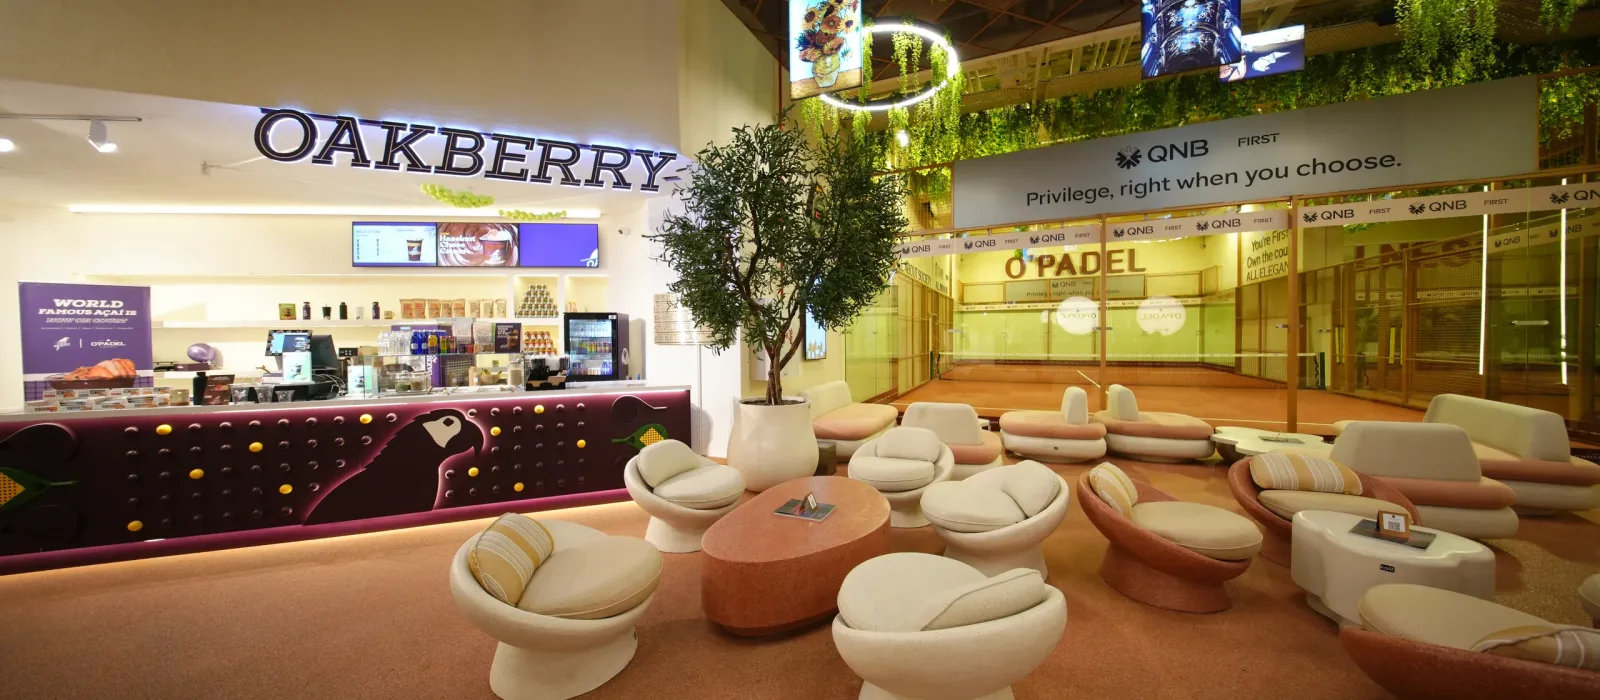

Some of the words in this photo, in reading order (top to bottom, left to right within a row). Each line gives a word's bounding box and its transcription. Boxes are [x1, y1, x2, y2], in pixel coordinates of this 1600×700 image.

[254, 108, 677, 192] OAKBERRY
[1147, 139, 1209, 164] QNB
[1237, 132, 1280, 148] FIRST
[1026, 183, 1114, 207] Privilege,
[1119, 176, 1171, 200] right
[1176, 172, 1239, 190] when
[1243, 165, 1289, 187] you
[1295, 151, 1403, 177] choose.
[1573, 189, 1600, 202] QN
[1320, 208, 1355, 221] QNB
[1428, 199, 1467, 213] QNB
[1483, 198, 1508, 206] FIRST
[1126, 225, 1154, 237] QNB
[1164, 224, 1183, 232] FIRST
[1211, 218, 1241, 231] QNB
[1502, 235, 1521, 246] QNB
[1564, 224, 1582, 236] NB
[911, 244, 931, 254] QNB
[974, 239, 996, 249] QNB
[1041, 232, 1065, 243] QNB
[1247, 256, 1261, 269] Own
[1262, 250, 1273, 264] the
[1274, 247, 1288, 259] cou
[53, 299, 124, 308] WORLD
